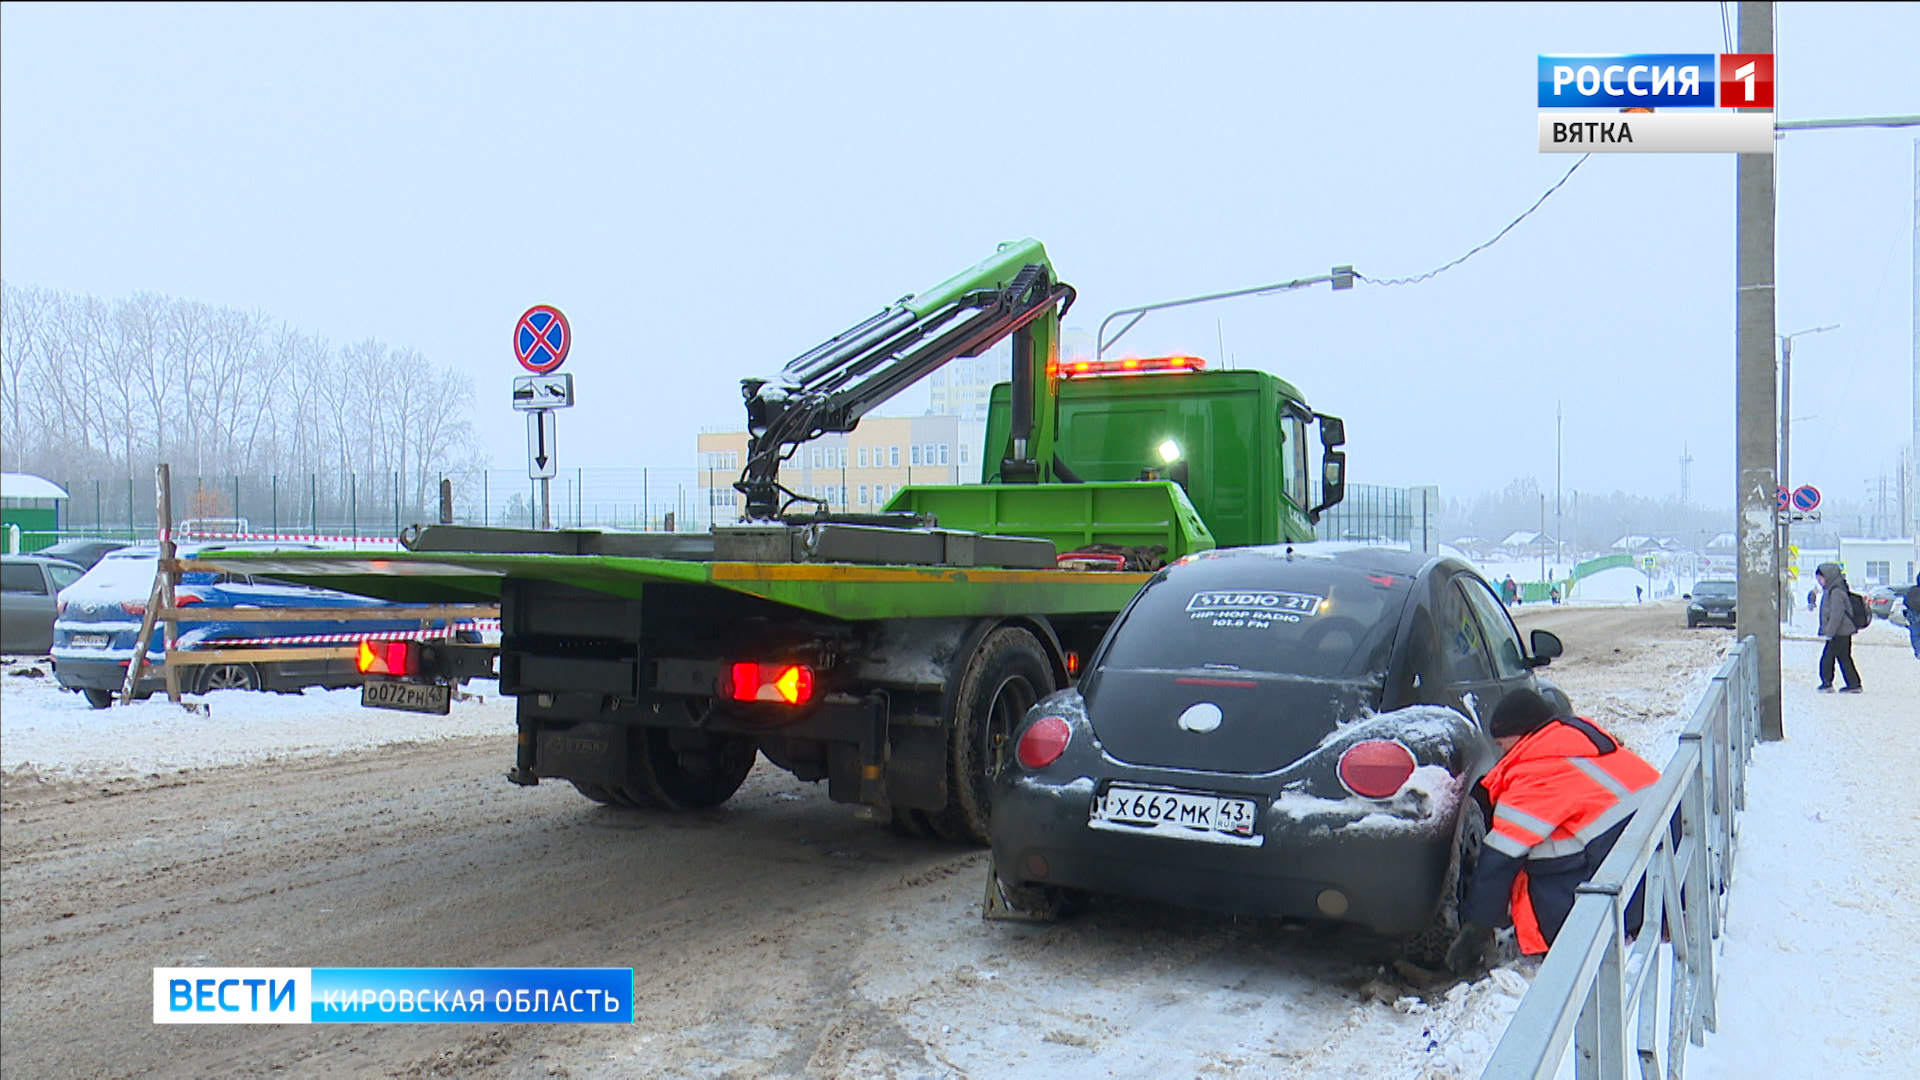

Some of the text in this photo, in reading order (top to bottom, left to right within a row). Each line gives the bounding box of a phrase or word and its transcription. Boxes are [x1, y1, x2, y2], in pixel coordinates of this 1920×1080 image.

[1284, 596, 1310, 610] 21
[1190, 610, 1301, 623] HIP-HOP RADIO
[1246, 620, 1270, 629] FM
[1115, 793, 1245, 826] Х662МК 43
